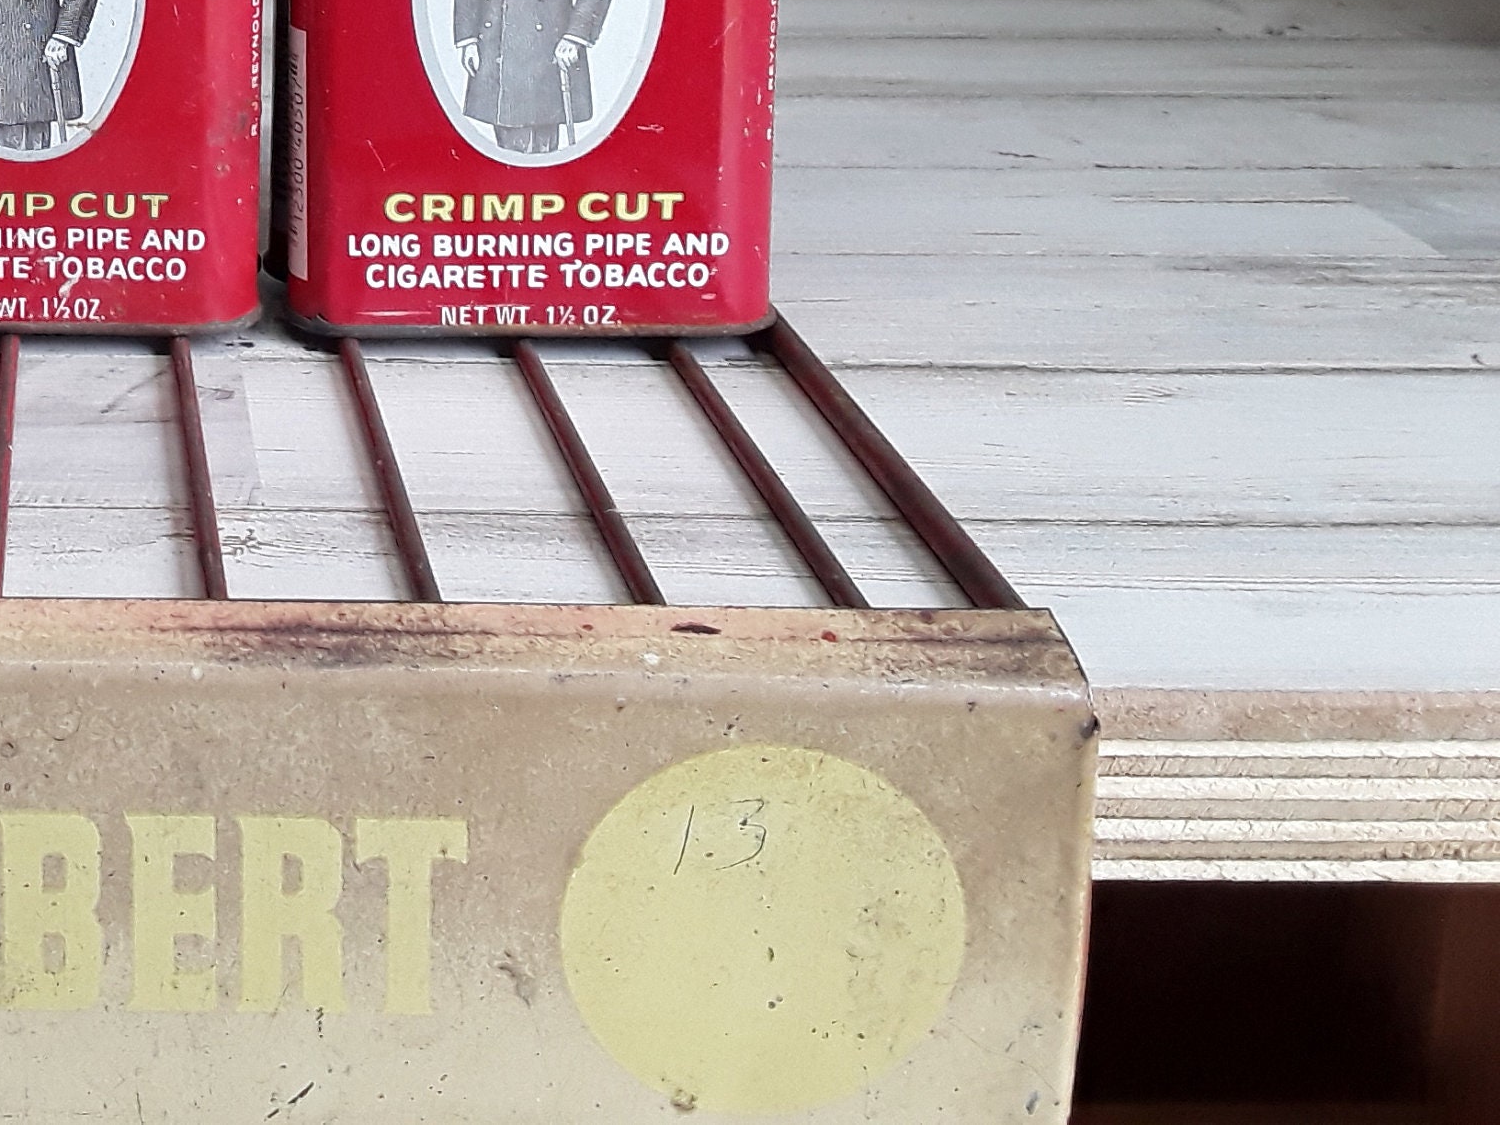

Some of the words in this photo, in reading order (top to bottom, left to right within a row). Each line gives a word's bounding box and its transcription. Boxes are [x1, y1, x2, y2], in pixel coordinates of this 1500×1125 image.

[69, 192, 170, 219] CUT
[383, 192, 566, 222] CRIMP
[578, 192, 686, 222] CUT
[67, 227, 132, 250] PIPE
[141, 229, 205, 251] AND
[348, 234, 421, 256] LONG
[434, 234, 574, 256] BURNING
[585, 234, 652, 255] PIPE
[662, 233, 729, 255] AND
[44, 251, 186, 281] TOBACCO
[365, 263, 549, 289] CIGARETTE
[560, 259, 711, 287] TOBACCO
[73, 299, 105, 320] OZ.
[441, 306, 493, 326] NET
[495, 305, 539, 325] WT.
[583, 306, 622, 326] OZ.
